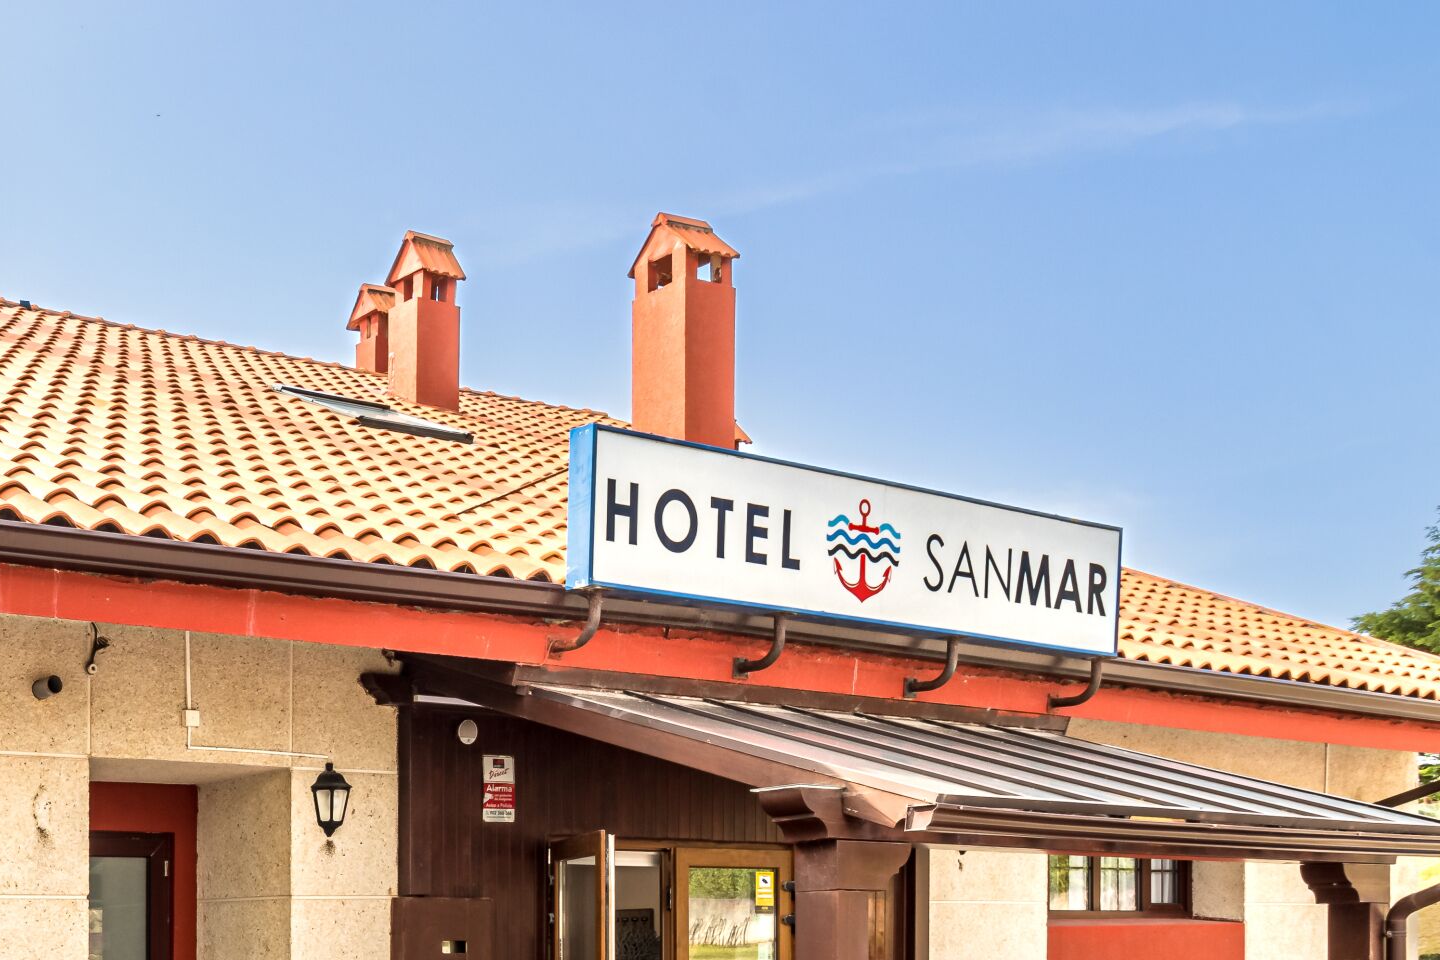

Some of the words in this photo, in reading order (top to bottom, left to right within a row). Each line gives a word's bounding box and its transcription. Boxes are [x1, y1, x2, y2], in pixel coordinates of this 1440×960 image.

[606, 478, 800, 570] HOTEL
[923, 533, 1108, 616] SANMAR
[486, 784, 512, 792] Alarma
